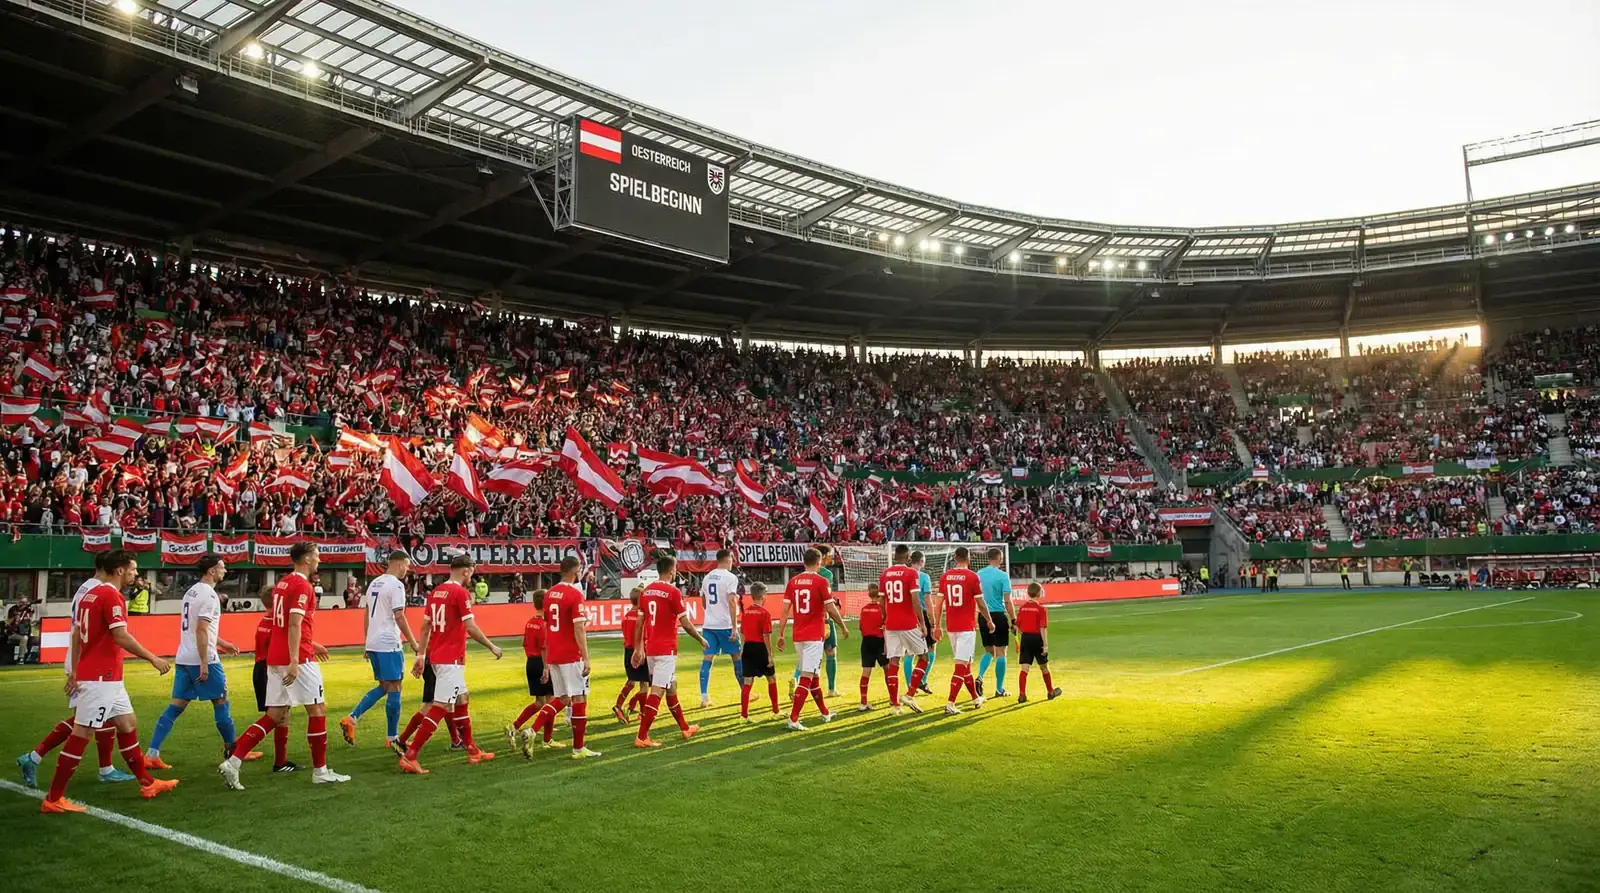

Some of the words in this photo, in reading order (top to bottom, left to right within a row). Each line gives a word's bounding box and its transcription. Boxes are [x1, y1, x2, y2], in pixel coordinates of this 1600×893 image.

[631, 144, 691, 174] OESTERREICH
[609, 172, 702, 215] SPIELBEGINN
[371, 591, 379, 618] 7
[708, 583, 718, 605] 9
[794, 588, 811, 614] 13
[946, 583, 963, 607] 19
[430, 603, 446, 633] 14
[548, 603, 560, 632] 3
[648, 600, 657, 627] 9
[95, 706, 106, 723] 3
